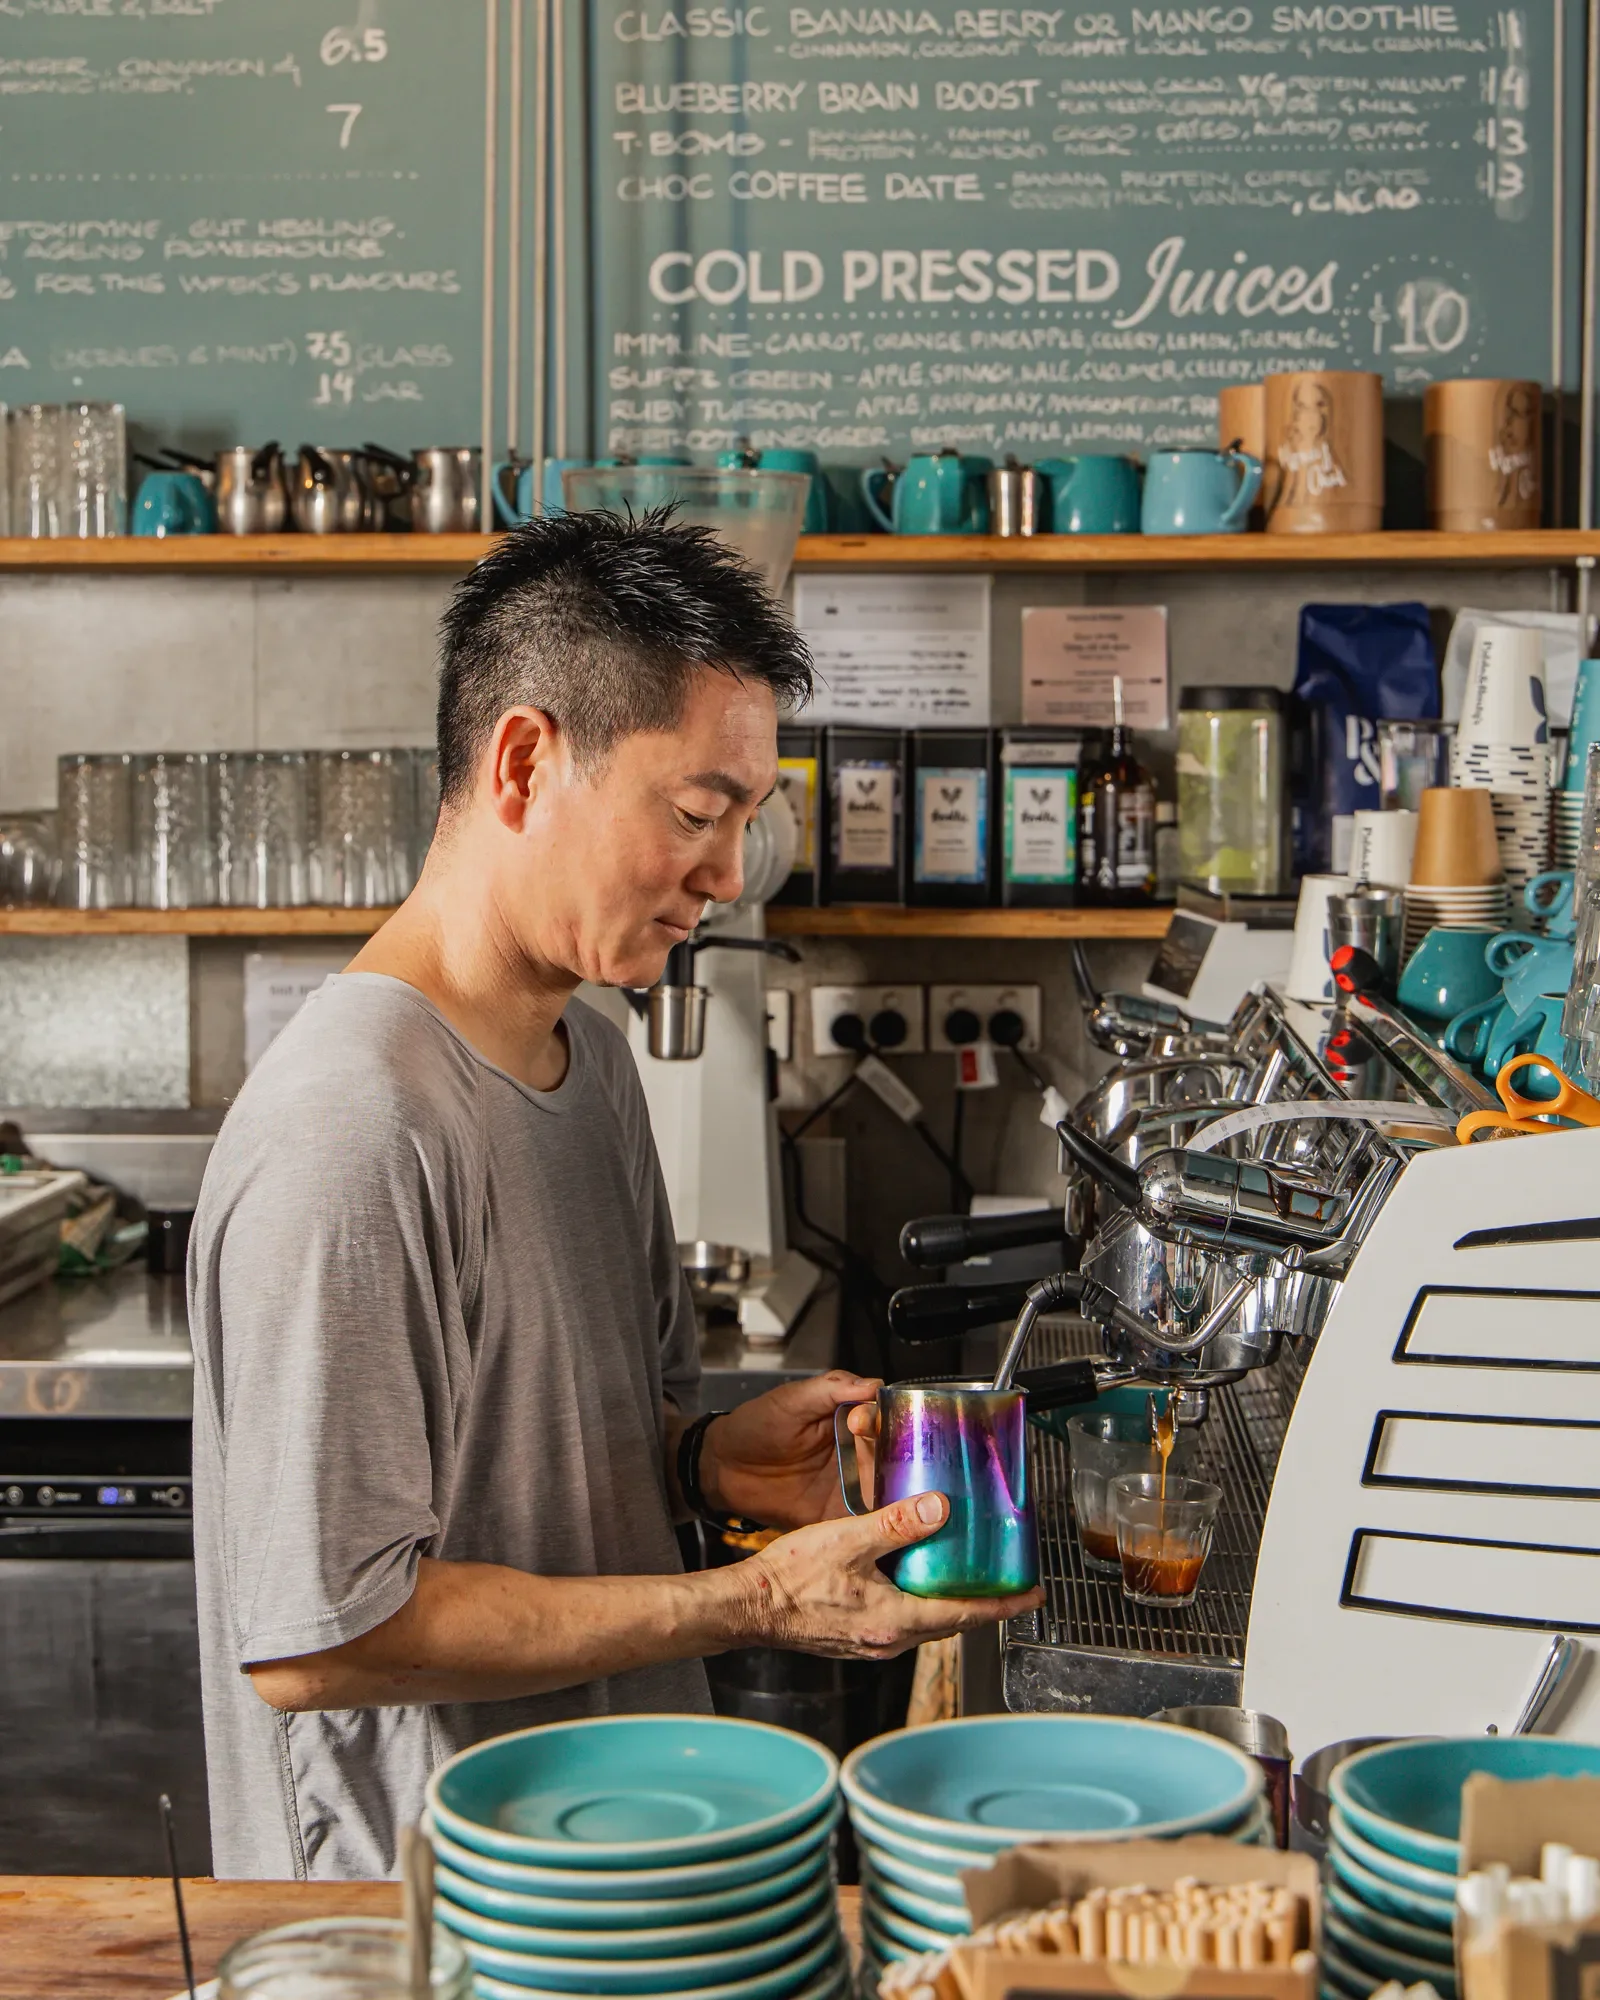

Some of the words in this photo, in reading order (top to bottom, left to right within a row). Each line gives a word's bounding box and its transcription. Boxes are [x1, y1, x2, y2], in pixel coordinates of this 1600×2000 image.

[613, 6, 772, 42] CLASSIC
[1074, 12, 1120, 37] OR
[1131, 6, 1253, 36] MANGO
[1271, 4, 1459, 33] SMOOTHIE
[319, 26, 388, 66] 6.5
[1134, 38, 1209, 56] LOCAL
[1316, 36, 1369, 54] FULL
[614, 81, 809, 116] BLUEBERRY
[818, 80, 920, 115] BRAIN
[934, 78, 1044, 112] BOOST
[325, 102, 363, 151] 7
[616, 173, 717, 202] CHOC
[728, 170, 870, 204] COFFEE
[884, 171, 987, 202] DATE
[98, 272, 167, 295] THIS
[647, 249, 826, 307] COLD
[841, 248, 1121, 306] PRESSED
[1110, 235, 1341, 330] Juices
[312, 370, 355, 406] 14
[727, 369, 834, 392] GREEN
[697, 397, 827, 423] TUESDAY
